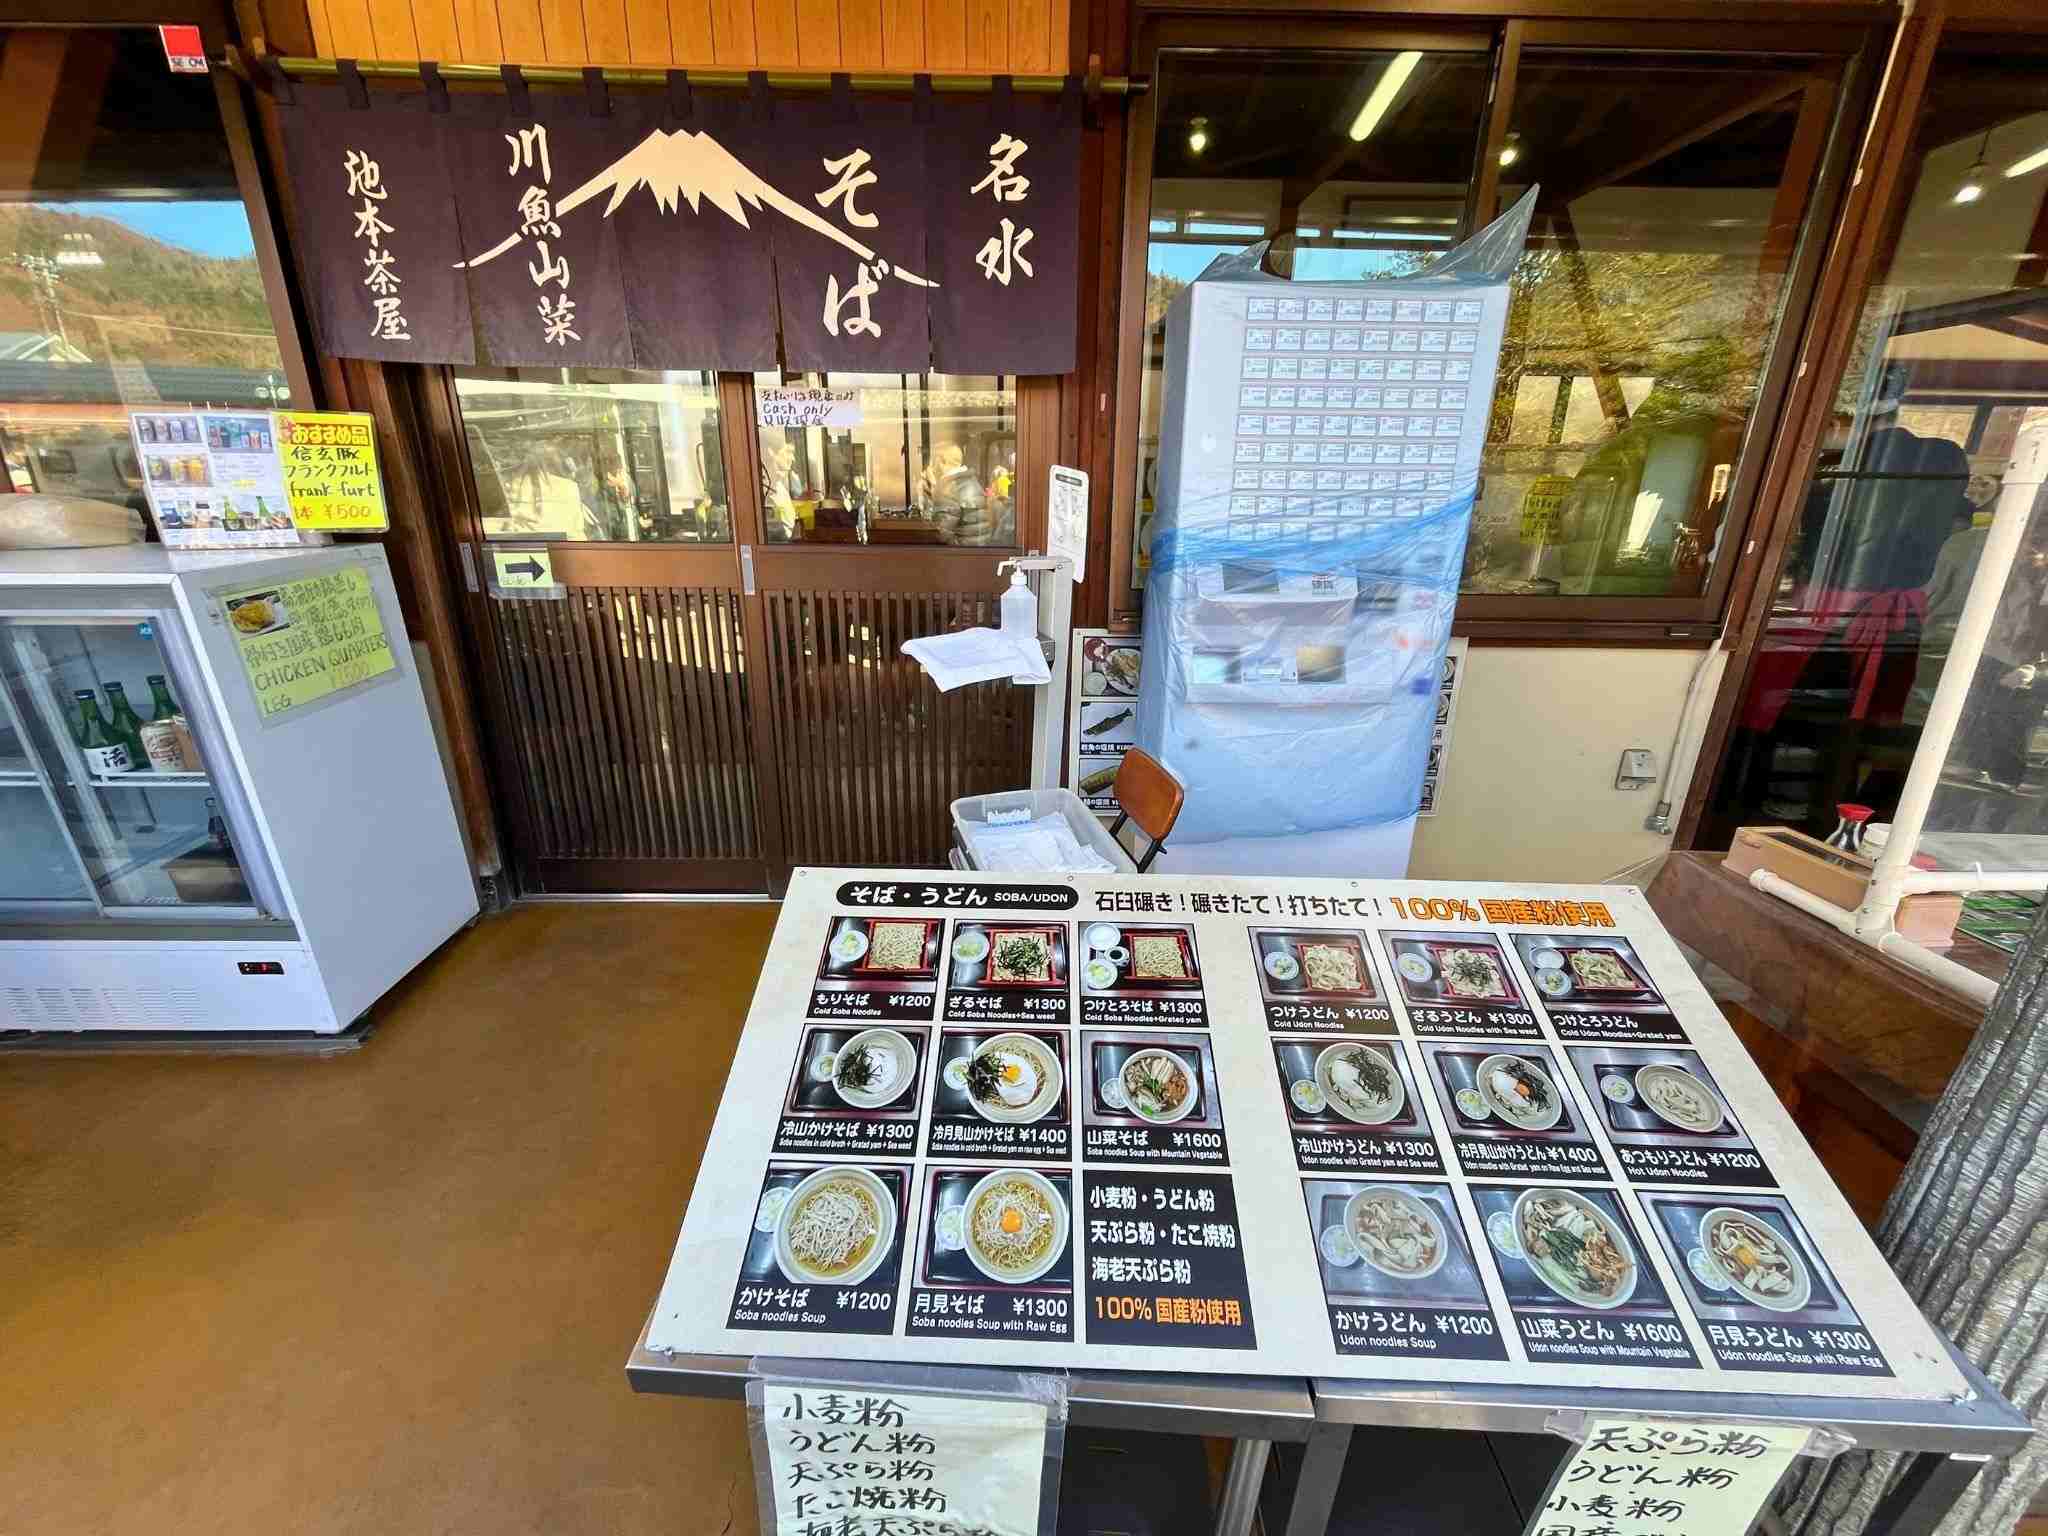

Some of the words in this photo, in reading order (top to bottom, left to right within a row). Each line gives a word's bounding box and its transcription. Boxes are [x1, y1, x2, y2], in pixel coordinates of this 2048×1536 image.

[971, 133, 1035, 286] 名水
[504, 122, 582, 347] 川魚山菜
[815, 148, 892, 339] そば
[343, 150, 412, 342] 池本茶屋
[763, 403, 796, 414] Cash
[804, 404, 833, 416] only
[291, 424, 369, 445] おすすめ品
[288, 463, 374, 478] フランクフルト
[290, 481, 329, 496] frank
[340, 481, 375, 496] furt
[255, 656, 327, 691] CHICKEN
[264, 694, 291, 714] LEG
[850, 886, 988, 906] そば・うどん
[994, 892, 1068, 904] SOBA/UDON
[1391, 897, 1480, 921] 100%
[1478, 899, 1616, 927] 国産粉使用
[816, 993, 870, 1006] もりそば
[889, 995, 931, 1007] ¥1200
[949, 996, 1003, 1008] ざるそば
[1023, 998, 1066, 1010] ¥1300
[1084, 1000, 1153, 1012] つけとろそば
[1160, 1002, 1201, 1013] ¥1300
[948, 1010, 965, 1018] Cold
[1270, 1006, 1339, 1019] つけうどん
[1345, 1008, 1389, 1020] ¥1200
[1412, 1010, 1482, 1024] ざるうどん
[1488, 1012, 1533, 1025] ¥1300
[1553, 1015, 1638, 1028] つけとろうどん
[1274, 1020, 1291, 1028] Cold
[781, 1121, 860, 1138] 冷山かけそば
[866, 1124, 914, 1138] ¥1300
[933, 1125, 1015, 1141] 冷月見山かけそば
[1019, 1128, 1066, 1142] ¥1400
[1087, 1130, 1148, 1146] 山菜そば
[1172, 1132, 1221, 1147] ¥1600
[1087, 1147, 1103, 1156] Soba
[1104, 1148, 1128, 1156] noodles
[1129, 1149, 1145, 1157] Soup
[1146, 1149, 1160, 1157] with
[1297, 1138, 1380, 1154] 冷山かけうどん
[1384, 1140, 1434, 1156] ¥1300
[1458, 1143, 1546, 1160] 冷月見山かけうどん
[1546, 1146, 1597, 1162] ¥1400
[1620, 1148, 1708, 1166] あつもりうどん
[1706, 1152, 1760, 1168] ¥1200
[1627, 1167, 1645, 1176] Hot
[1646, 1168, 1670, 1176] Udon
[1671, 1168, 1708, 1178] Noodles
[1090, 1185, 1215, 1212] 小麦粉・うどん粉
[1090, 1220, 1236, 1248] 天ぷら粉・たこ焼粉
[1092, 1256, 1191, 1284] 海老天ぷら粉
[738, 1286, 810, 1307] かけそば
[836, 1291, 891, 1310] ¥1200
[914, 1294, 985, 1314] 月見そば
[1013, 1298, 1068, 1317] ¥1300
[735, 1310, 759, 1320] Soba
[762, 1310, 798, 1322] noodles
[801, 1312, 826, 1324] Soup
[1096, 1296, 1152, 1320] 100%
[1155, 1297, 1242, 1326] 国産粉使用
[912, 1316, 935, 1327] Soba
[938, 1317, 974, 1328] noodles
[977, 1318, 1000, 1330] Soup
[1003, 1320, 1023, 1331] with
[1027, 1321, 1047, 1332] Raw
[1050, 1322, 1067, 1334] Egg
[1336, 1311, 1426, 1333] かけうどん
[1434, 1314, 1493, 1335] ¥1200
[1521, 1318, 1614, 1340] 山菜うどん
[1621, 1322, 1683, 1342] ¥1600
[1339, 1334, 1367, 1345] Udon
[1369, 1336, 1408, 1348] noodles
[1411, 1337, 1437, 1349] Soup
[1707, 1325, 1803, 1348] 月見うどん
[1808, 1329, 1871, 1350] ¥1300
[1529, 1342, 1549, 1353] Udon
[1550, 1343, 1579, 1354] noodles
[1581, 1344, 1599, 1355] Soup
[1600, 1344, 1616, 1355] with
[1718, 1349, 1744, 1361] Udon
[1745, 1350, 1785, 1362] noodles
[1786, 1352, 1812, 1364] Soup
[1813, 1353, 1837, 1365] with
[783, 1394, 910, 1428] 小麦粉
[789, 1430, 936, 1455] うどん粉
[1586, 1426, 1773, 1458] 天ぷら粉
[788, 1460, 936, 1488] 天ぷら粉
[1567, 1456, 1740, 1489] うどん粉
[792, 1486, 946, 1519] たこ焼粉
[1546, 1494, 1686, 1522] 小麦粉
